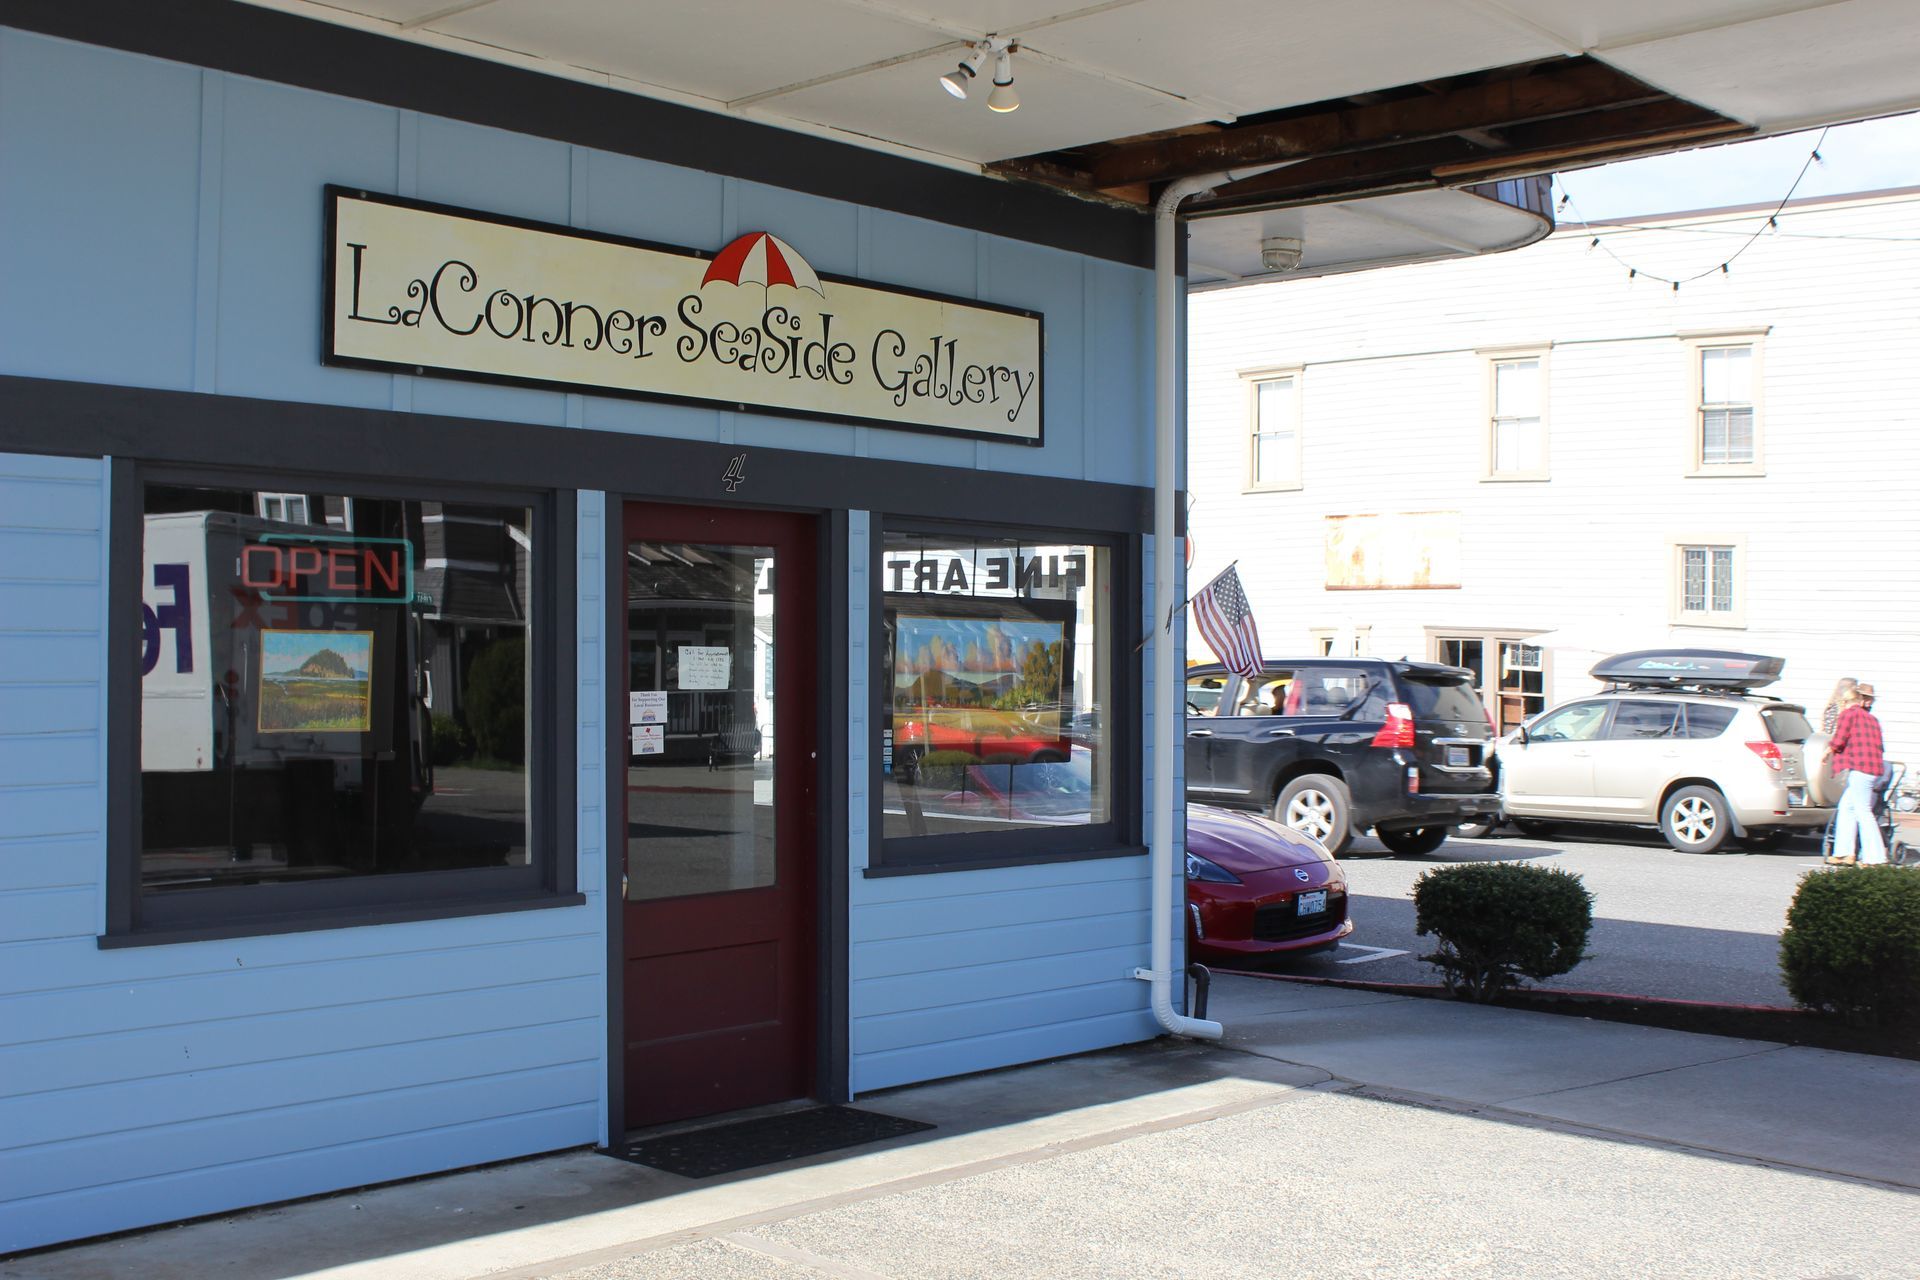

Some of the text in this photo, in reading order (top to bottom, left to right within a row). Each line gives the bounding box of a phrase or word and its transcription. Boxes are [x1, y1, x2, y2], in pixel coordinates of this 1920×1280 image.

[346, 243, 667, 360] LaConner
[870, 328, 1037, 423] Gallery
[721, 452, 747, 493] 4
[241, 545, 399, 591] OPEN
